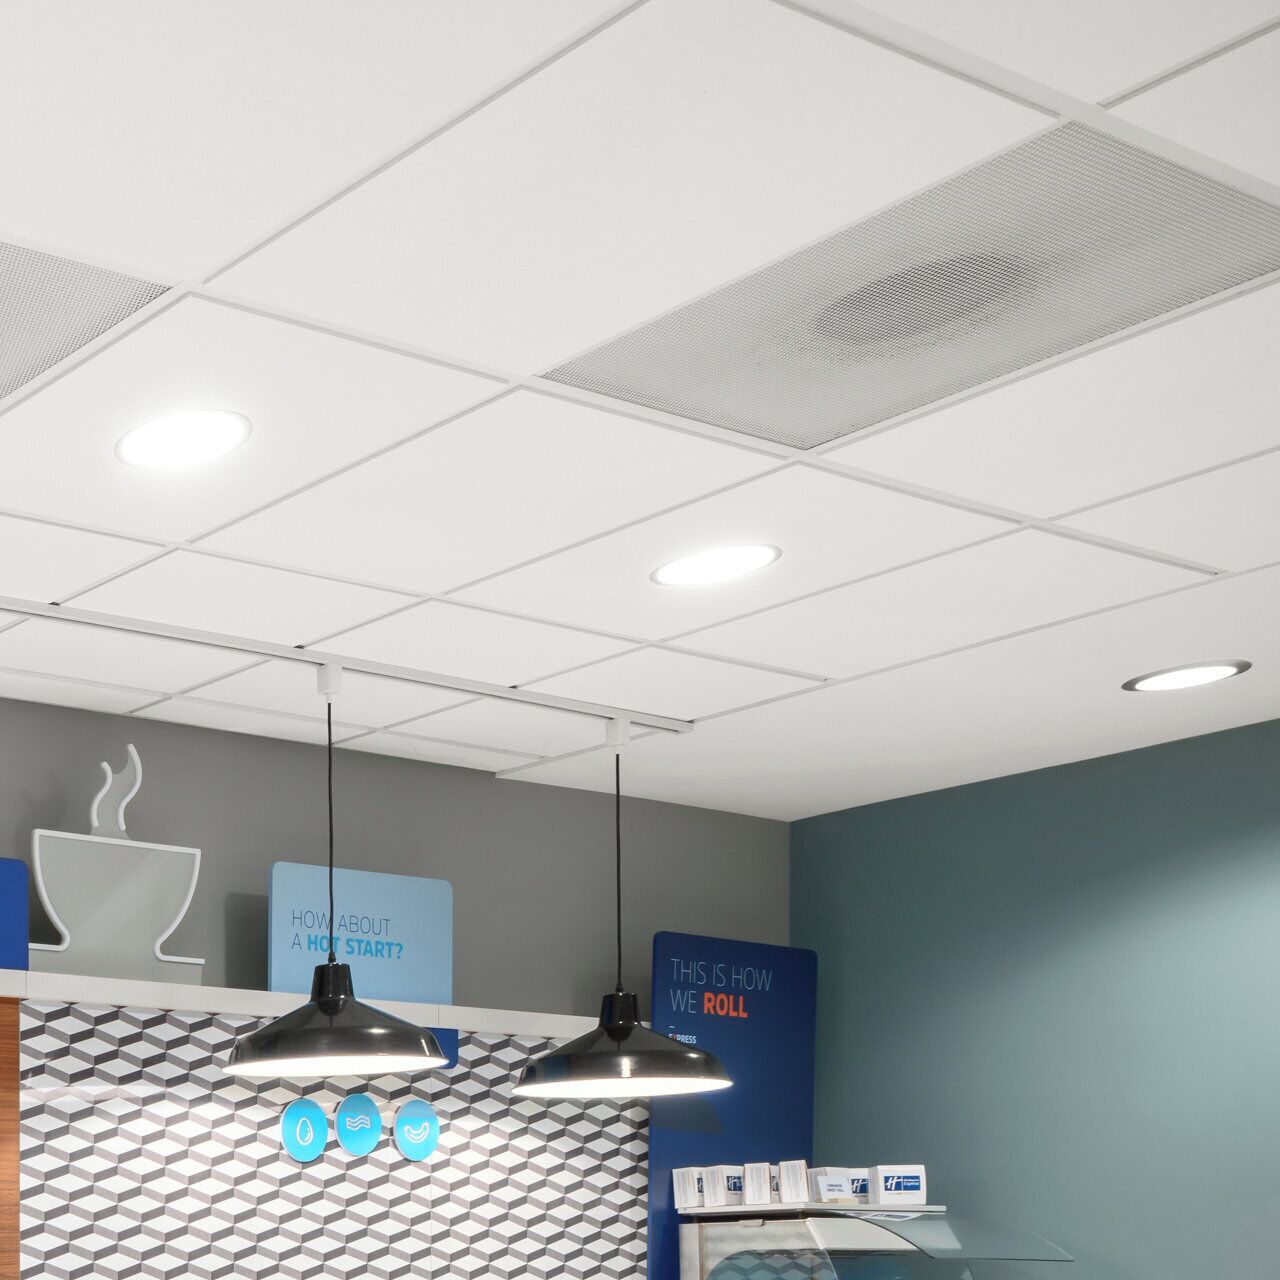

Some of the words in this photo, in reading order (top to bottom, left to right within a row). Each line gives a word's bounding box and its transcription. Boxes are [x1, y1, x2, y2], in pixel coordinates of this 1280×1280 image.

[292, 909, 331, 930] HOW
[337, 914, 391, 936] ABOUT
[291, 933, 302, 950] A
[307, 933, 340, 953] HOT
[345, 937, 404, 960] START?
[670, 958, 706, 985] THIS
[712, 963, 726, 987] IS
[732, 966, 772, 991] HOW
[670, 988, 697, 1014] WE
[703, 991, 749, 1019] ROLL
